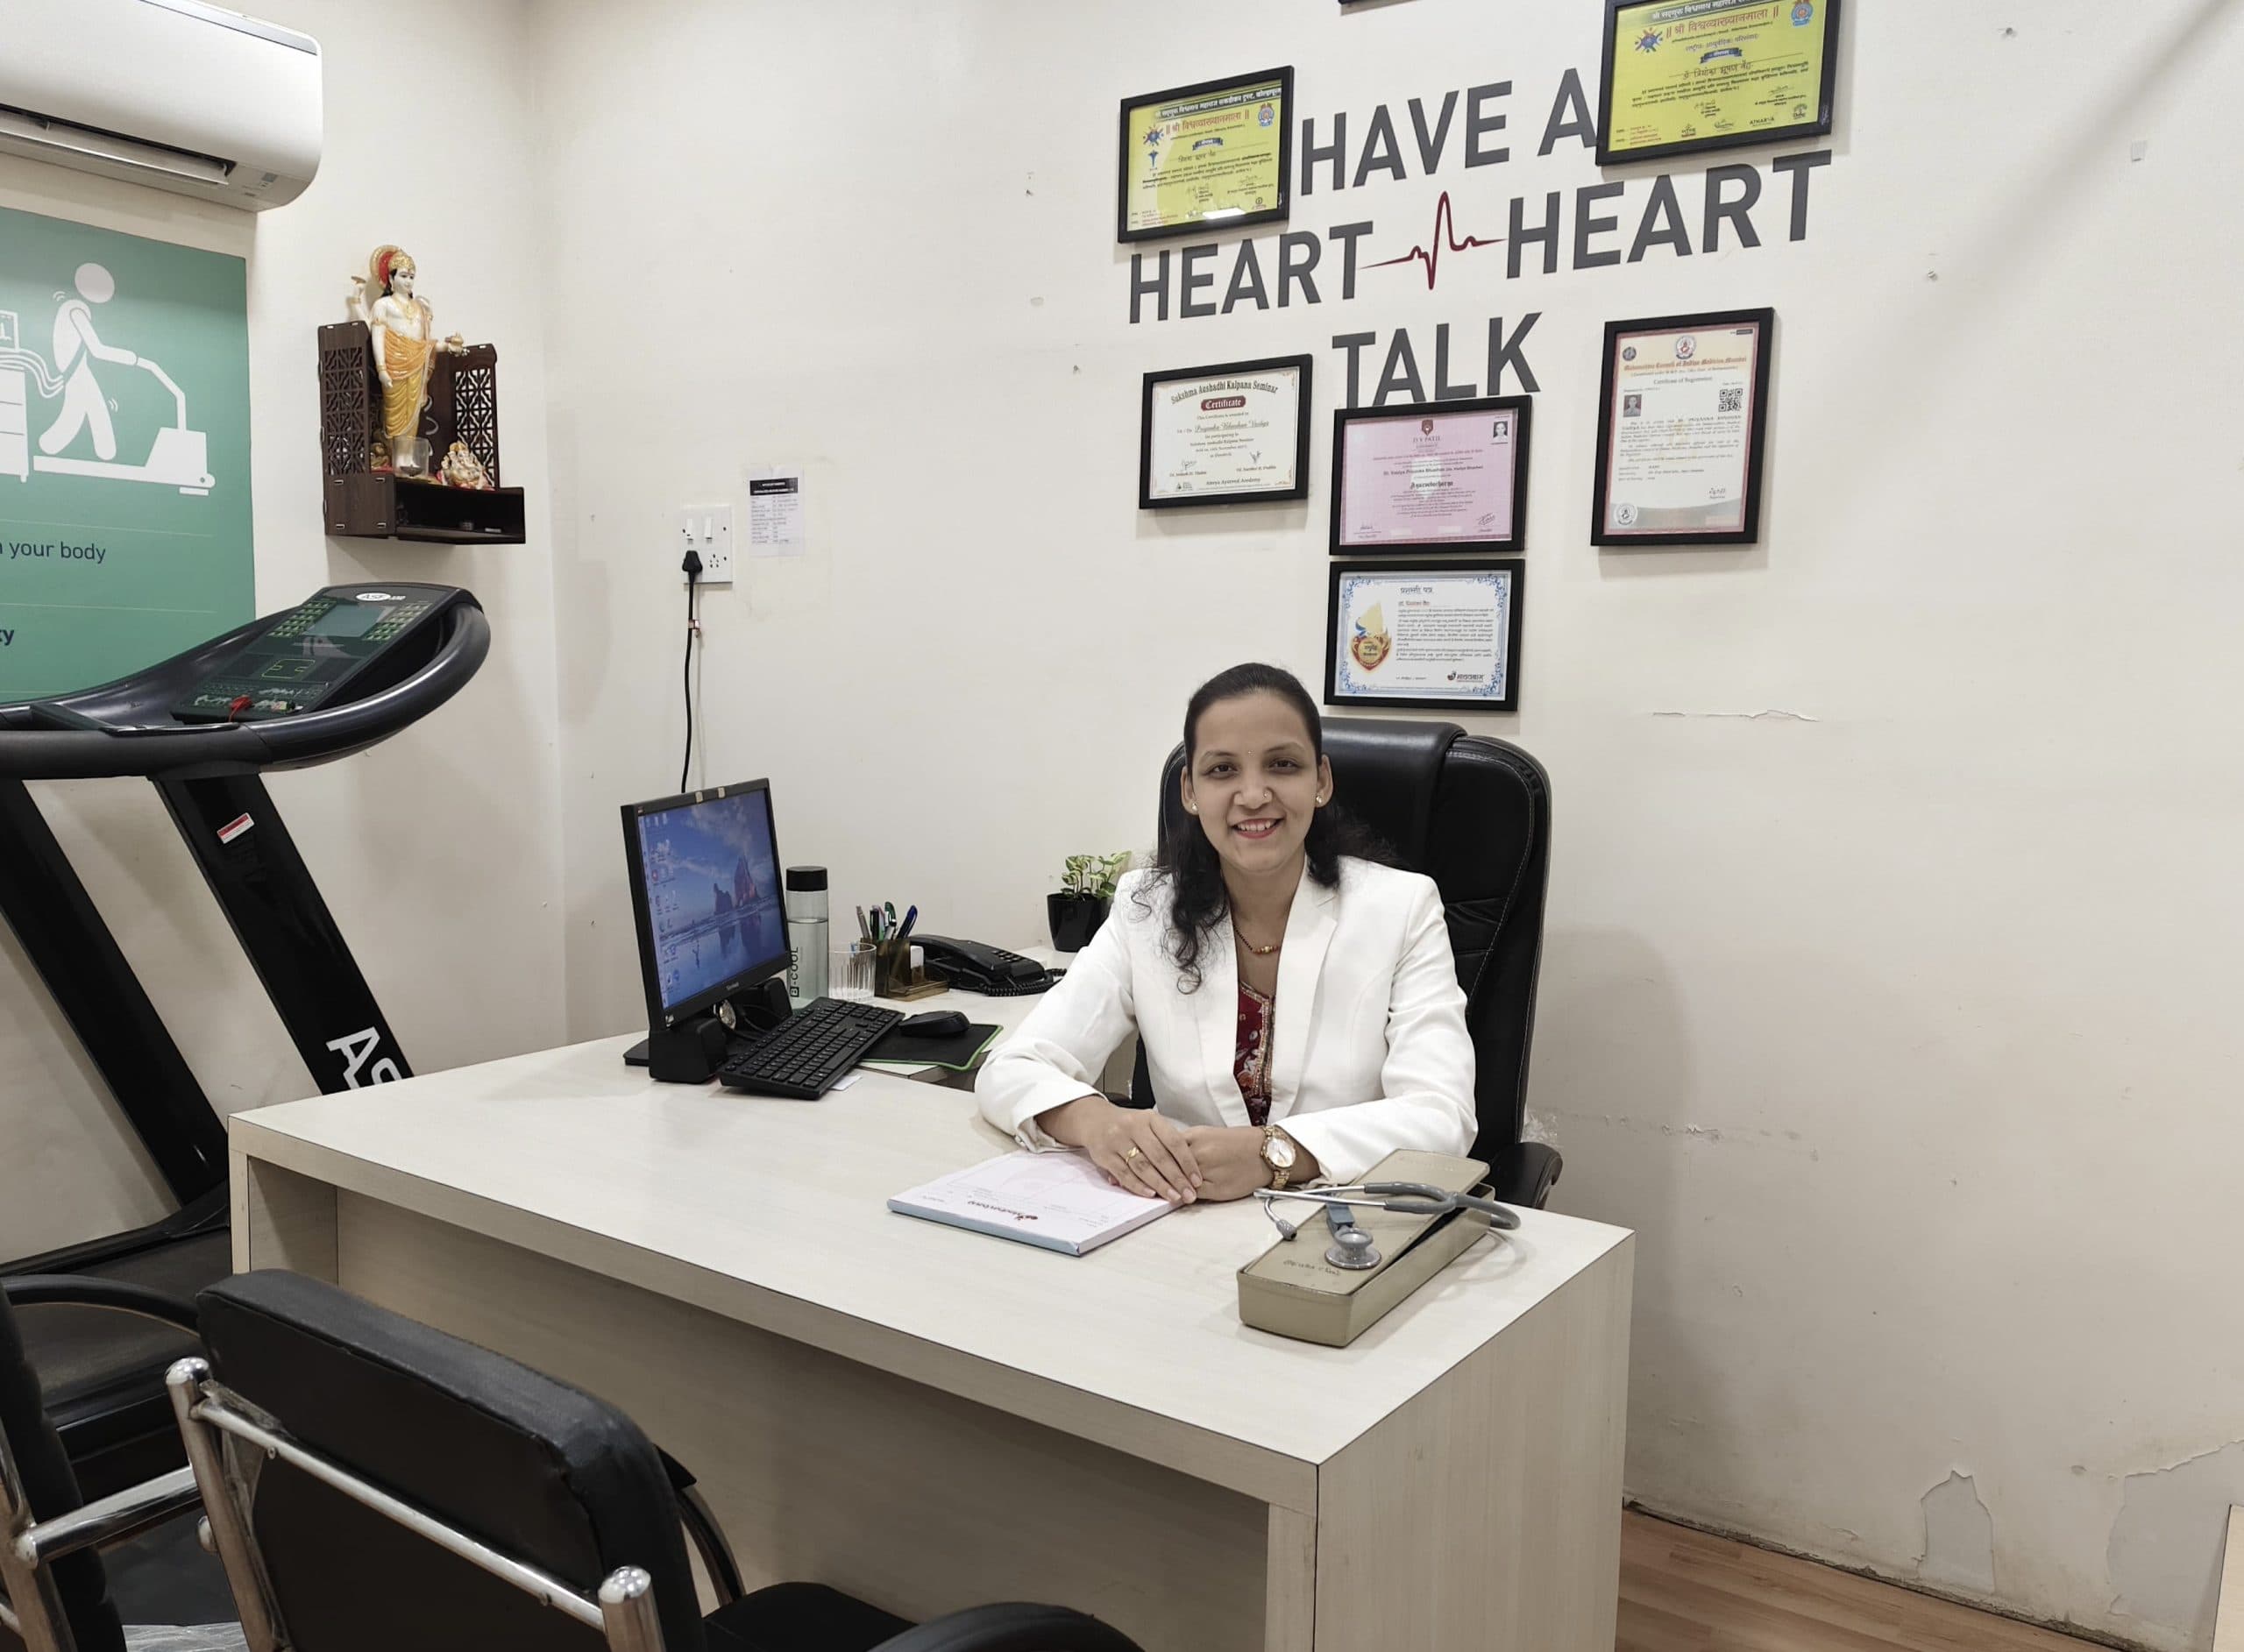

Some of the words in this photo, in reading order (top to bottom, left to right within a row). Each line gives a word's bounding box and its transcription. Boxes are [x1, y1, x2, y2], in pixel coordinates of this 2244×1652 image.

[1301, 81, 1512, 195] HAVE
[1537, 68, 1598, 156] A
[1130, 221, 1373, 323] HEART
[1507, 150, 1832, 279] HEART
[1331, 312, 1542, 408] TALK
[1205, 399, 1242, 409] Certificate
[1226, 380, 1252, 393] Kalpana
[1253, 380, 1279, 394] Seminar
[9, 542, 55, 560] your
[60, 541, 106, 564] body
[790, 947, 799, 997] B-COOL
